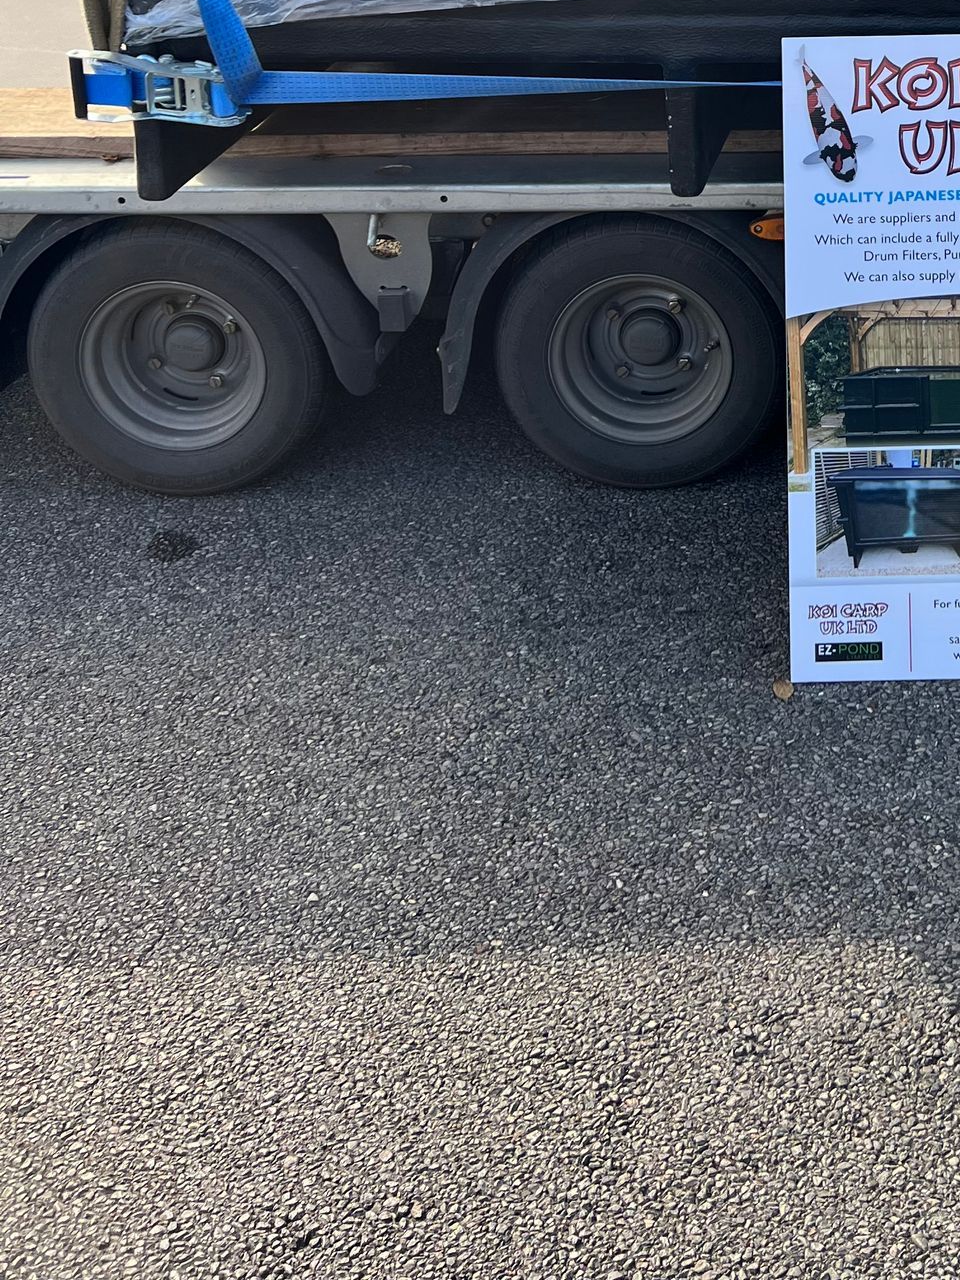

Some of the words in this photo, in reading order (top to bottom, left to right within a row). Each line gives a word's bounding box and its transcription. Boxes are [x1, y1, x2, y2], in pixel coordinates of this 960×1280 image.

[814, 191, 884, 205] QUALITY
[833, 214, 853, 224] We
[858, 216, 876, 224] are
[880, 212, 931, 226] suppliers
[935, 212, 956, 222] and
[814, 234, 853, 245] Which
[857, 236, 877, 244] can
[881, 232, 922, 244] include
[926, 235, 932, 243] a
[936, 231, 959, 245] fully
[864, 251, 898, 262] Drum
[902, 250, 941, 261] Filters,
[844, 272, 865, 282] We
[869, 274, 888, 282] can
[892, 270, 915, 282] also
[919, 270, 955, 283] supply
[808, 604, 837, 620] KOI
[840, 602, 889, 618] CARP
[933, 599, 951, 609] For
[820, 620, 844, 635] UK
[846, 619, 878, 635] LTD
[818, 643, 880, 656] EZ-POND
